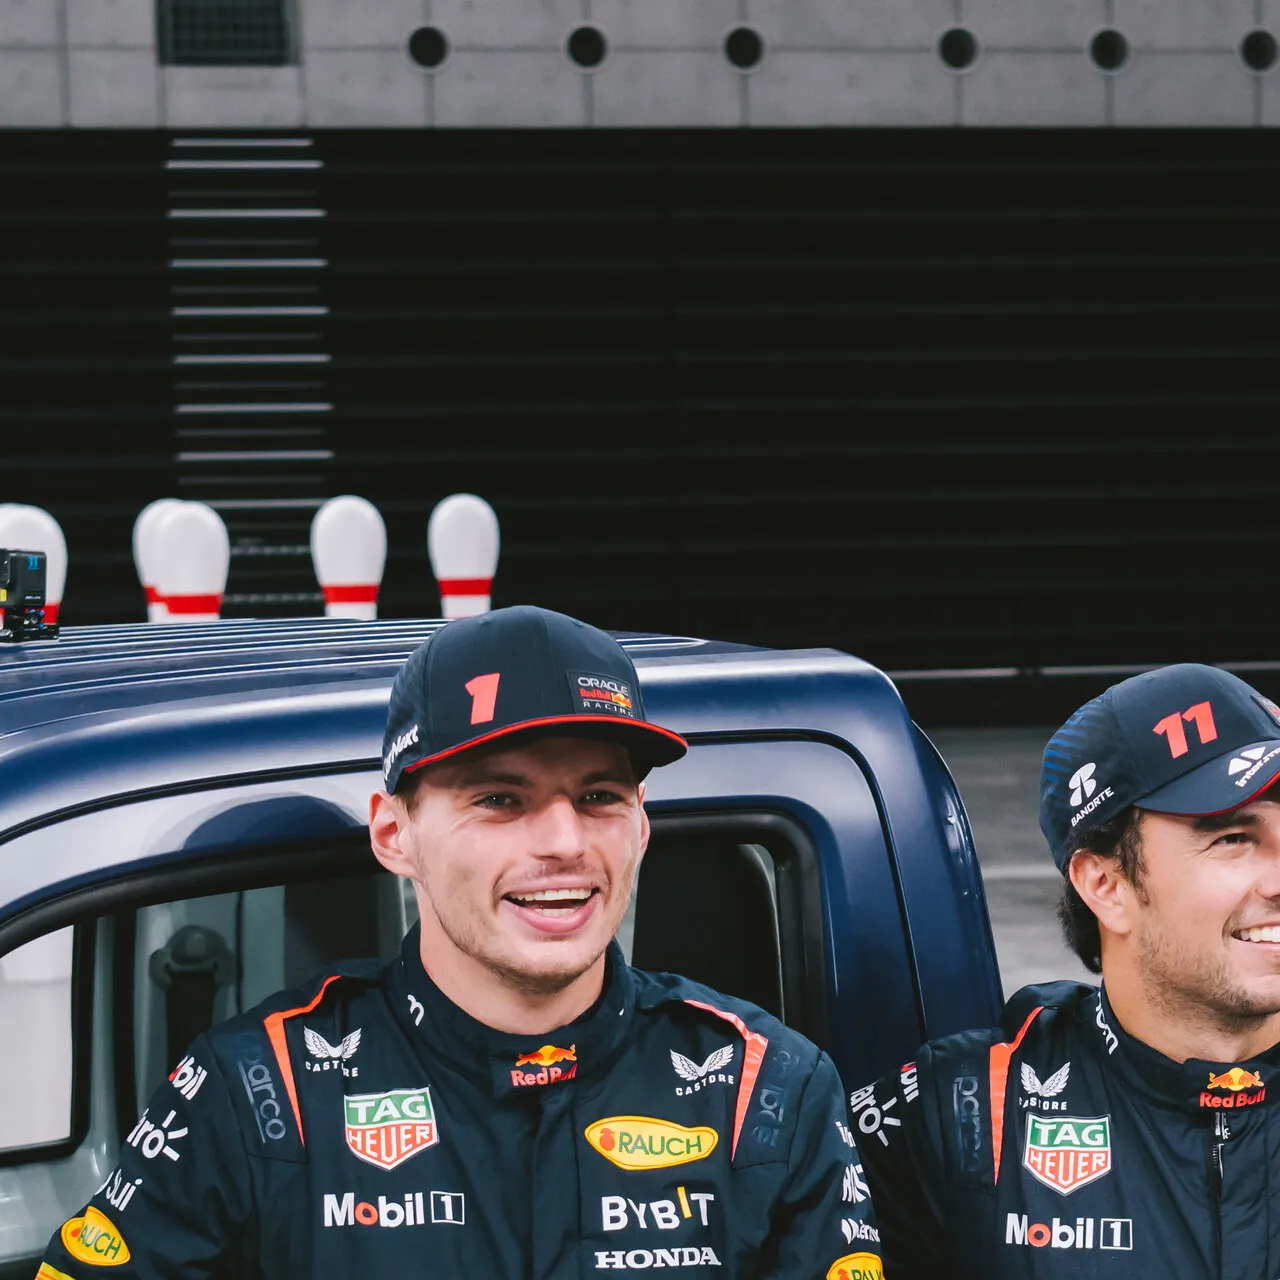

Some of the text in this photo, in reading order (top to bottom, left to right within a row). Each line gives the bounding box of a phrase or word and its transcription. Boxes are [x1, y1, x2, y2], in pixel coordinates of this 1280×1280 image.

[464, 672, 500, 725] 1
[577, 676, 629, 697] ORACLE
[583, 701, 634, 718] RACING
[1152, 701, 1218, 759] 11
[1070, 786, 1115, 828] BANORTE
[511, 1068, 549, 1087] Red
[675, 1073, 735, 1096] CASTORE
[348, 1091, 429, 1124] TAG
[1200, 1087, 1266, 1108] Red Bull
[347, 1121, 431, 1160] HEUER
[618, 1132, 703, 1156] RAUCH
[1033, 1121, 1106, 1147] TAG
[1030, 1148, 1106, 1185] HEUER
[324, 1192, 425, 1227] Mobil
[601, 1186, 715, 1232] BYBIT
[1006, 1213, 1094, 1249] Mobil
[594, 1246, 721, 1268] HONDA
